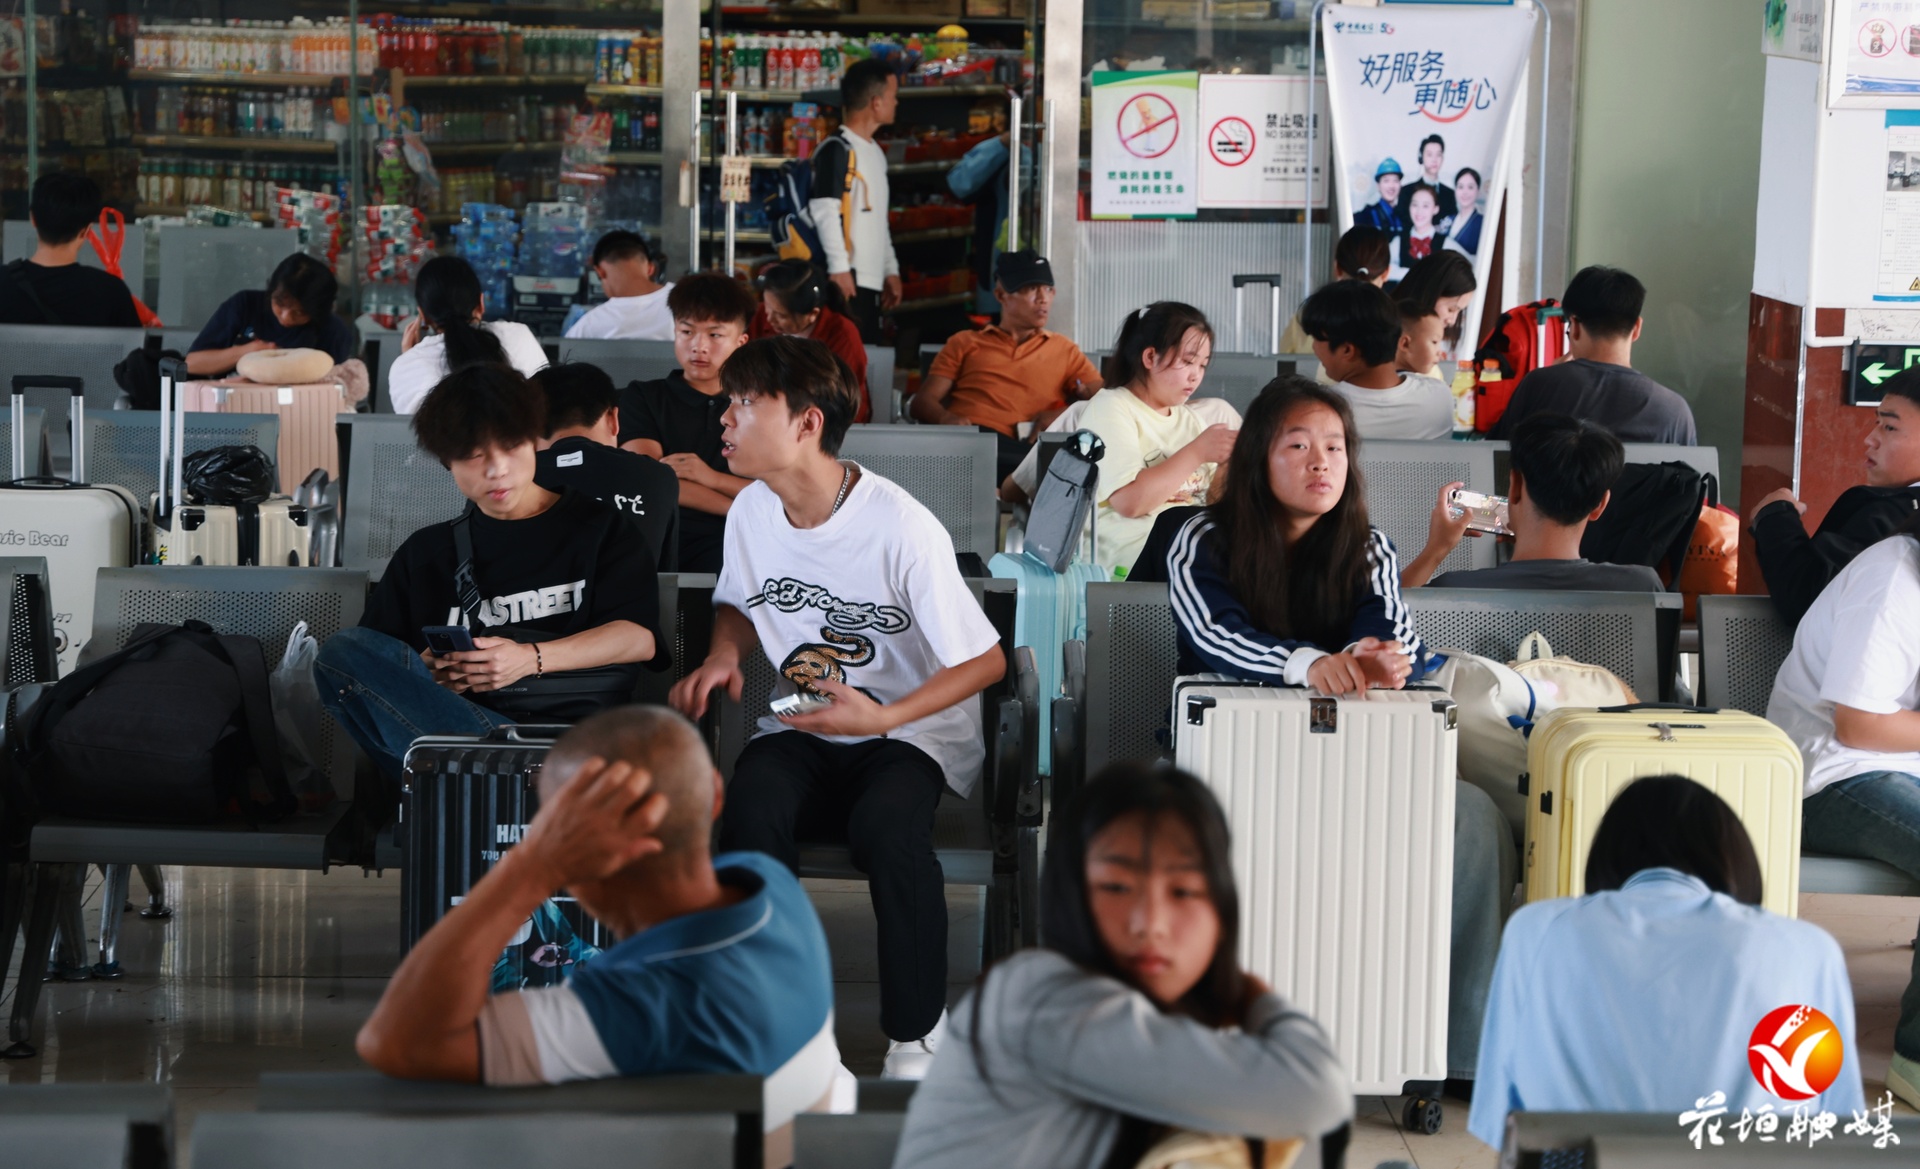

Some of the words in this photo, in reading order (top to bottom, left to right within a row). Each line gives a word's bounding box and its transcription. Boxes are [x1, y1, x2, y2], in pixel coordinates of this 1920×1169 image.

[1358, 50, 1445, 94] 好服务
[1408, 77, 1498, 116] 更随心
[1265, 130, 1277, 139] NO
[0, 529, 26, 546] sic
[29, 530, 69, 547] Bear
